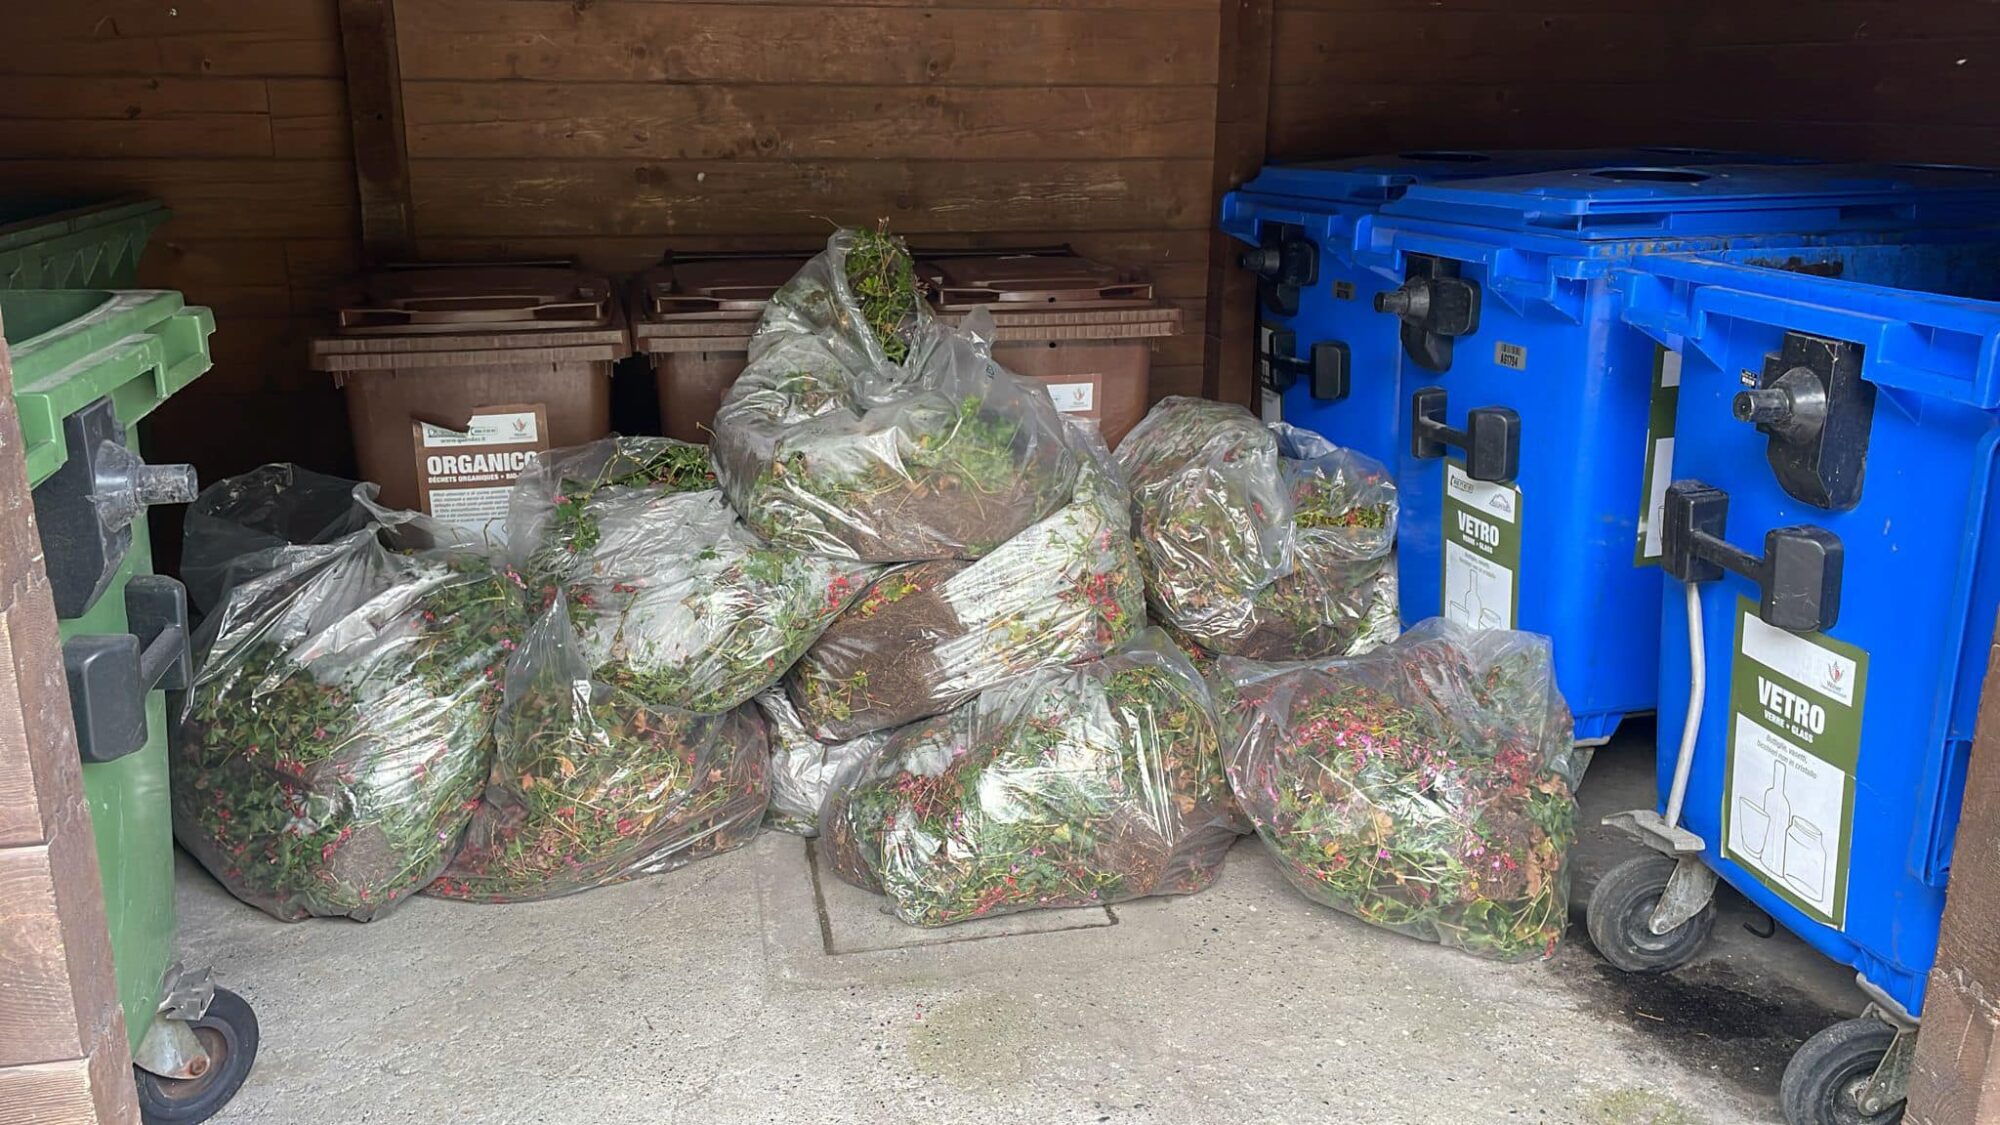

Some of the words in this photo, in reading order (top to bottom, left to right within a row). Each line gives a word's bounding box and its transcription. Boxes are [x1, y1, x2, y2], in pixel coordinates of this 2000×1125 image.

[1457, 510, 1500, 547] VETRO
[1757, 675, 1826, 735] VETRO
[1791, 724, 1814, 744] GLASS
